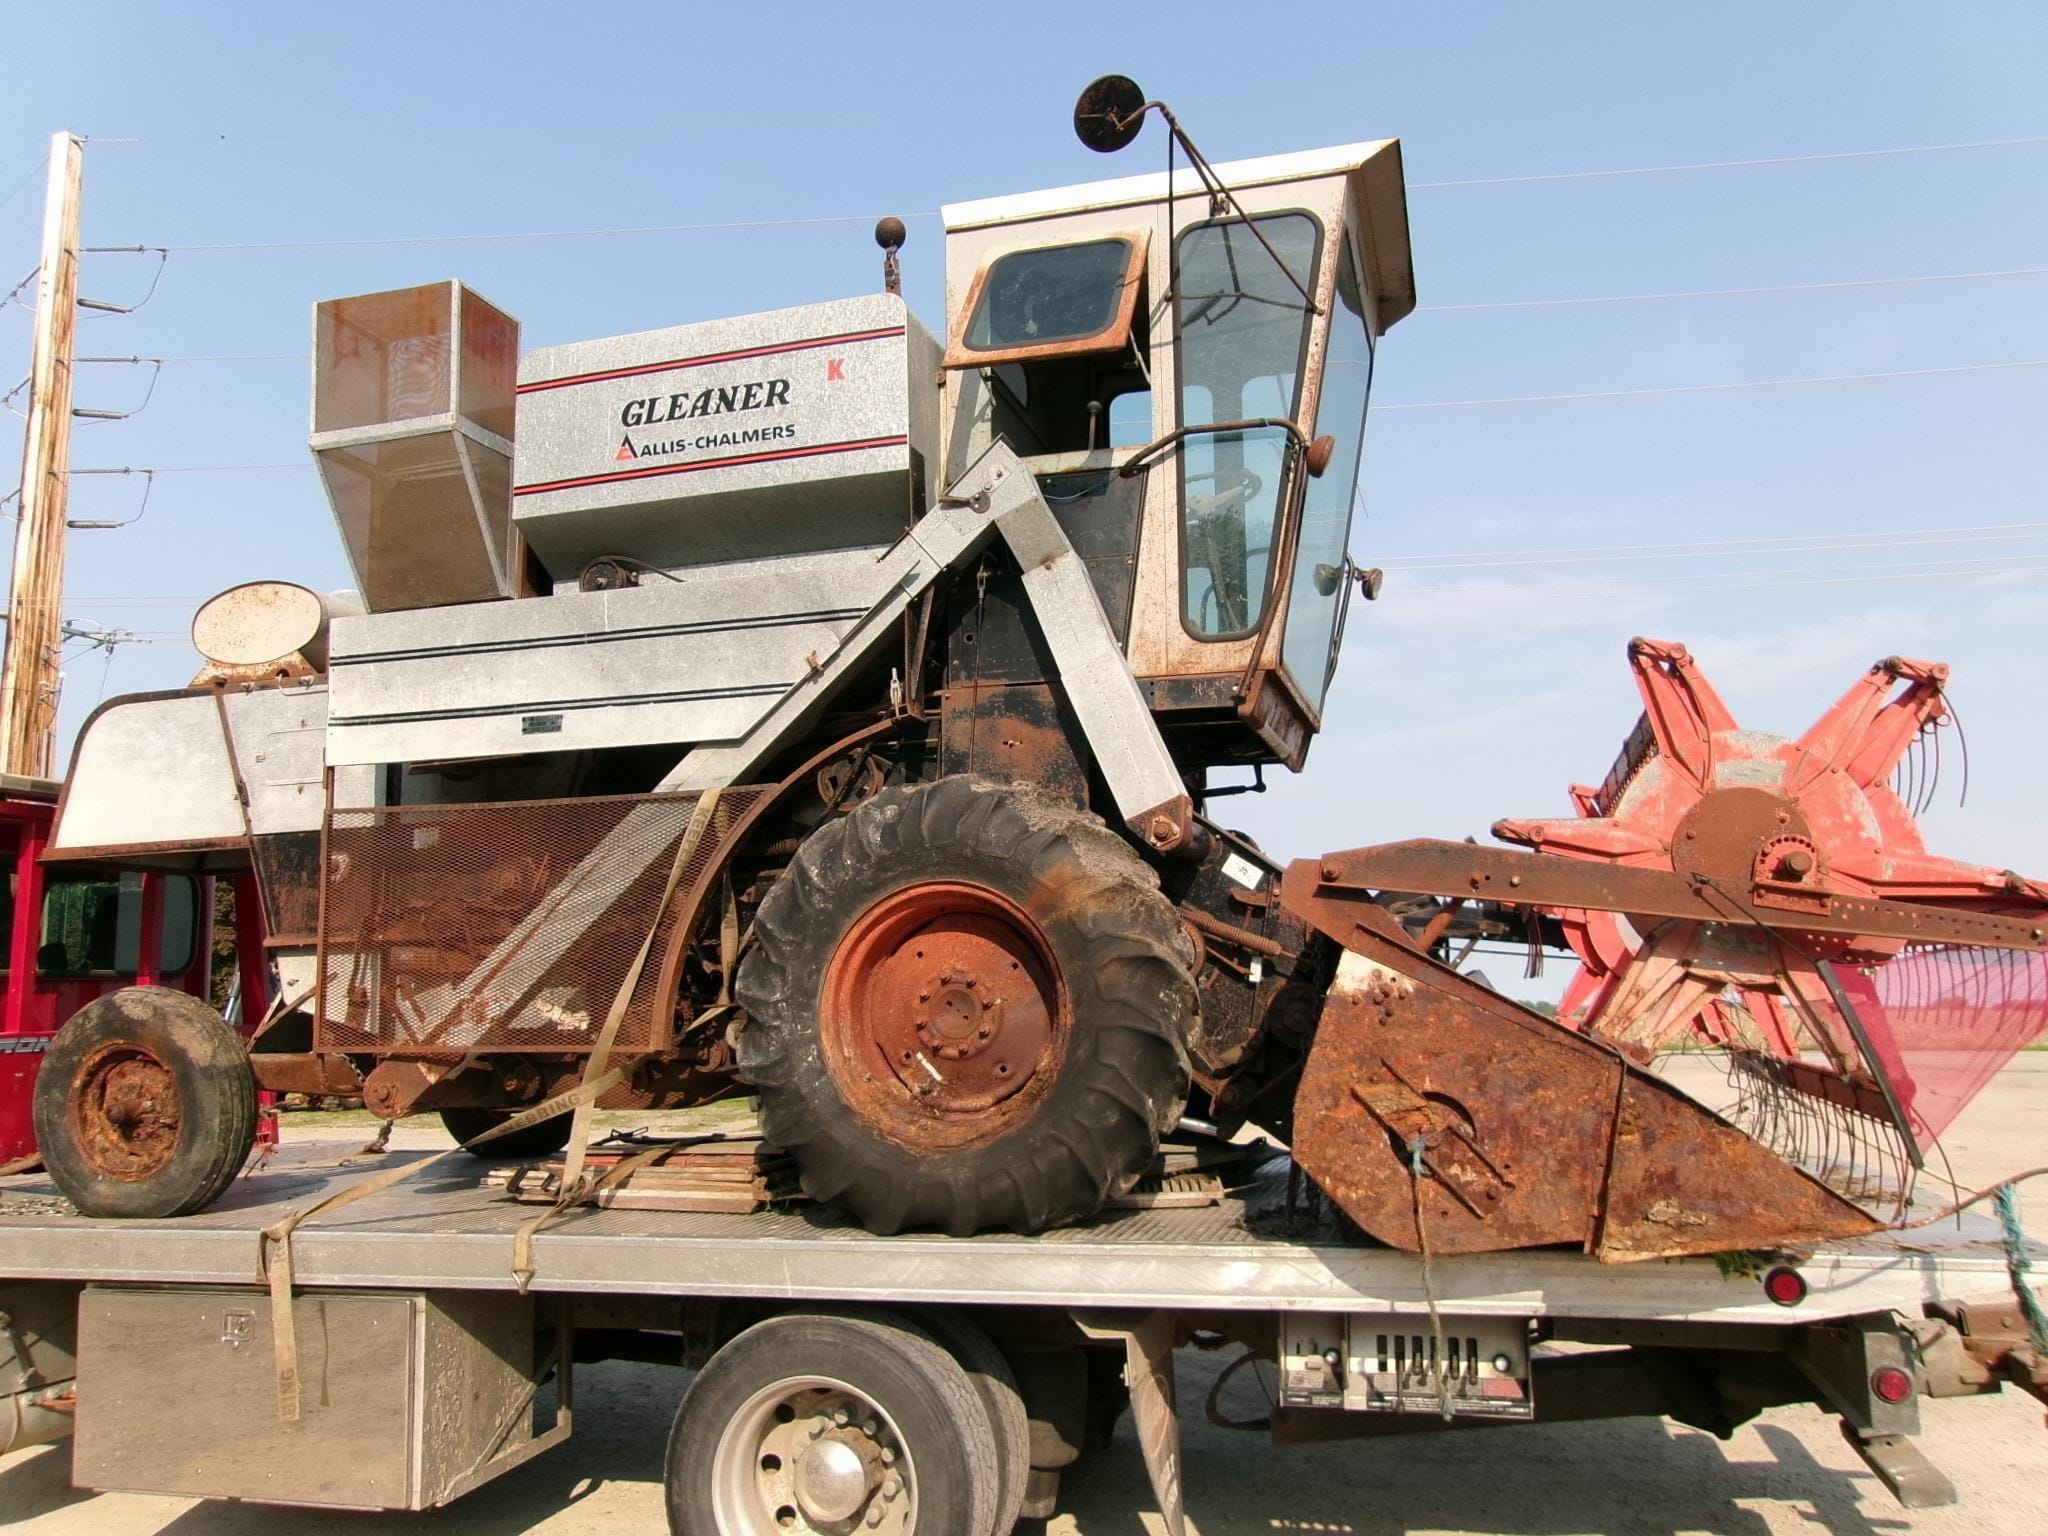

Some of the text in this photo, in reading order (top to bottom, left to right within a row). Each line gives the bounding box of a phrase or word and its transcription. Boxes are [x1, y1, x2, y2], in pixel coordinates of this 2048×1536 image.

[827, 358, 846, 381] K
[621, 378, 791, 428] GLEANER
[640, 424, 796, 458] ALLIS-CHALMERS
